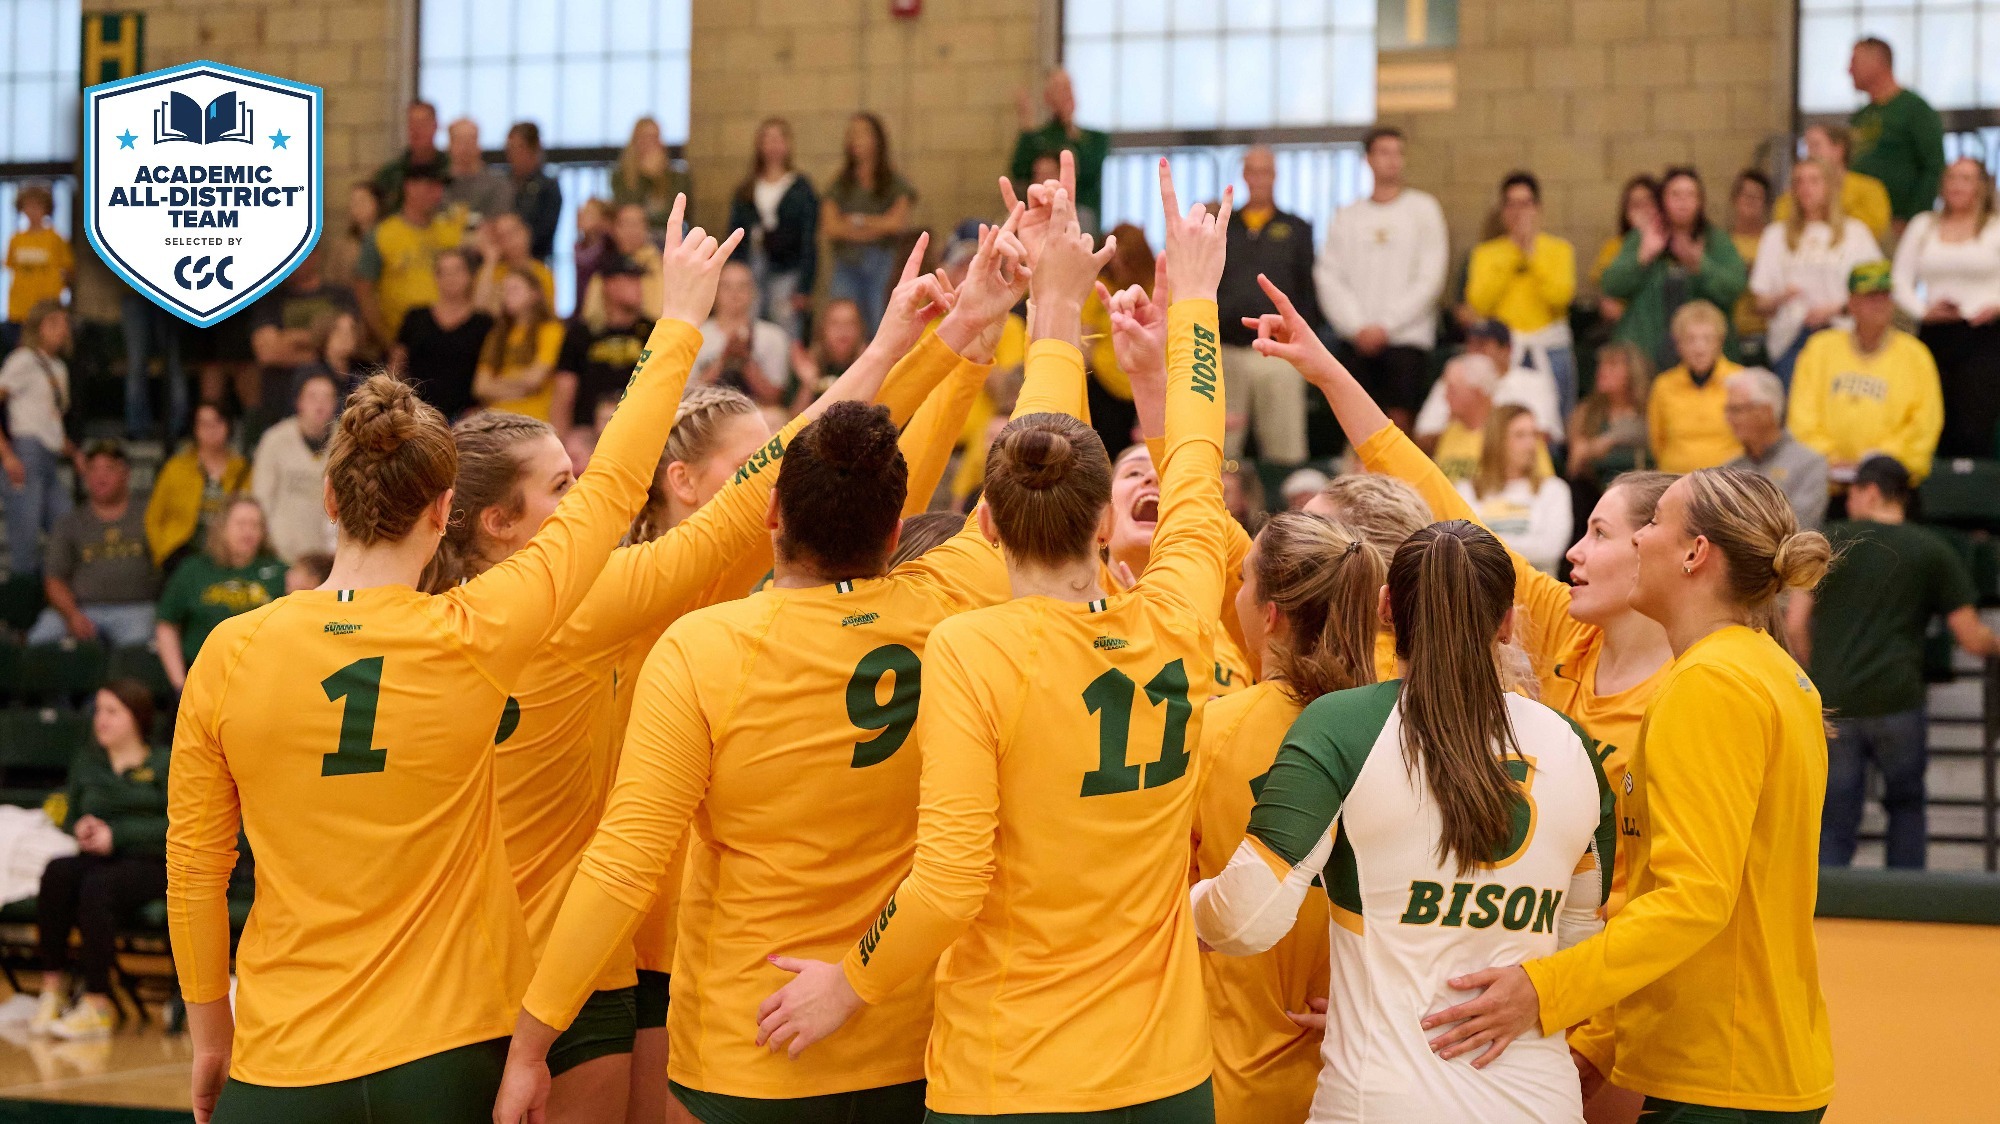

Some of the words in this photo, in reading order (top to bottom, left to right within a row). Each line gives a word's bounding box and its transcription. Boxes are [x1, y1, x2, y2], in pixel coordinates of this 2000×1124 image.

[1190, 322, 1217, 403] BISON
[324, 624, 363, 633] SUMMIT
[319, 655, 388, 777] 1
[845, 643, 922, 768] 9
[1080, 657, 1192, 798] 11
[1399, 879, 1563, 935] BISON
